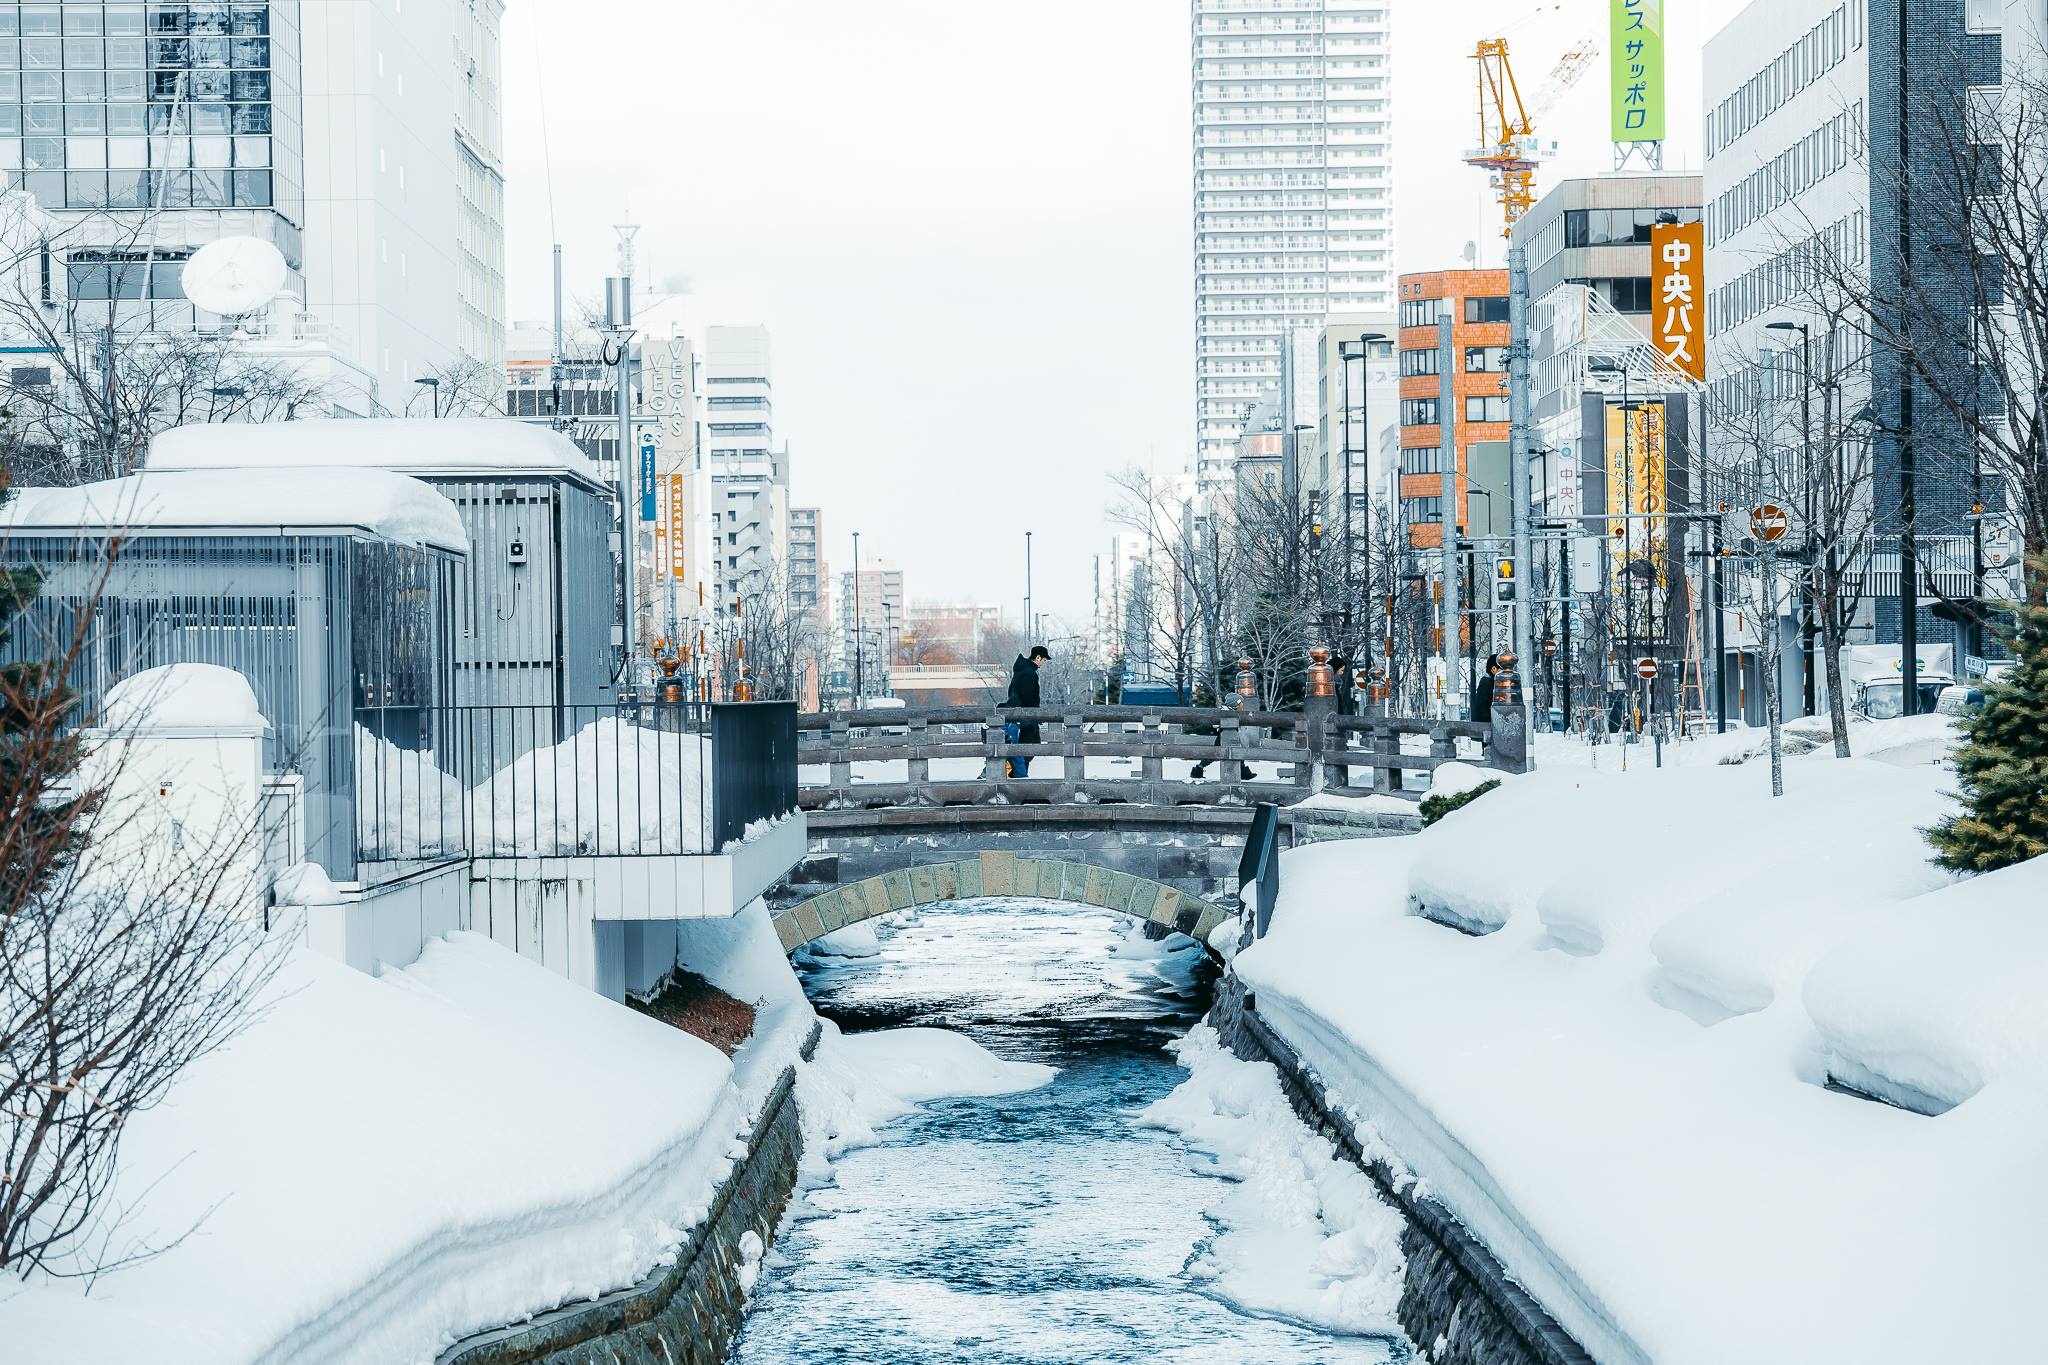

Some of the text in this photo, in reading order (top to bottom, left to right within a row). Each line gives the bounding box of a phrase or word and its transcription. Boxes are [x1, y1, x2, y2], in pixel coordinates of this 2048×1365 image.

[1624, 40, 1647, 129] サッポロ
[1662, 239, 1693, 363] 中央バス
[668, 342, 686, 437] VEGAS
[1615, 450, 1624, 545] 高速バスネットワク
